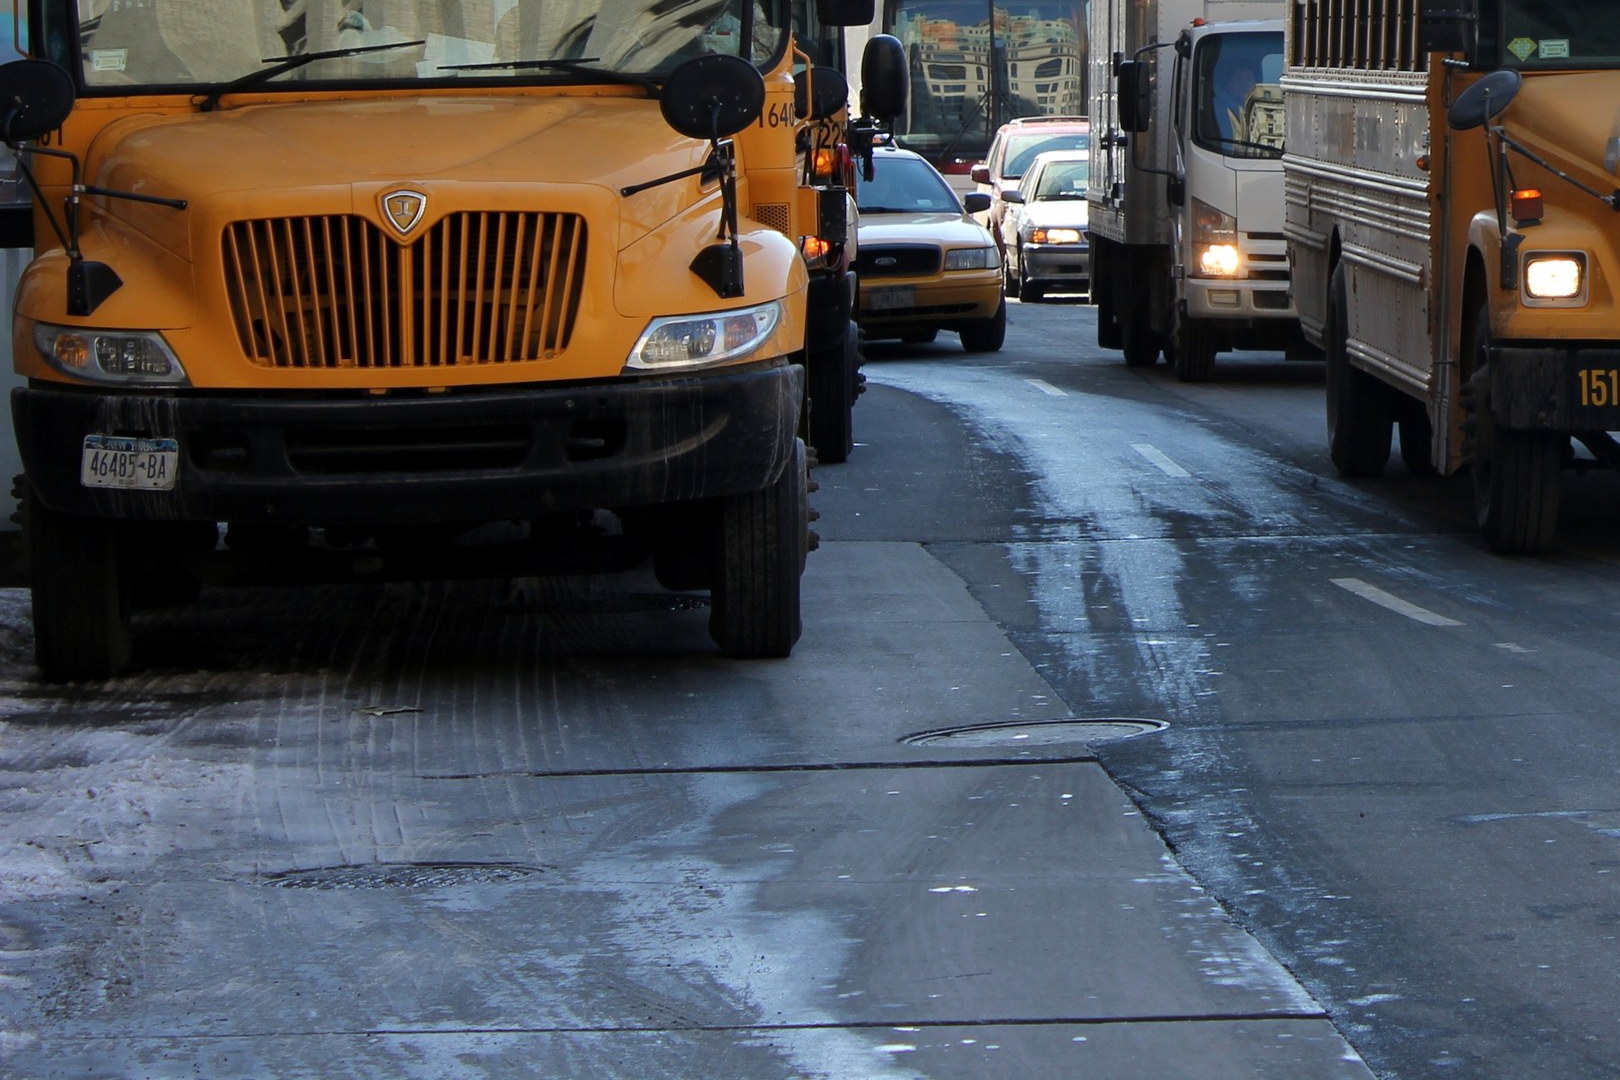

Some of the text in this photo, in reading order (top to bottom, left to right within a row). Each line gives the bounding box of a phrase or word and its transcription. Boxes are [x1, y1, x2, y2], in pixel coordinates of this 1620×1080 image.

[1579, 370, 1618, 406] 151
[90, 451, 167, 479] 46485 BA
